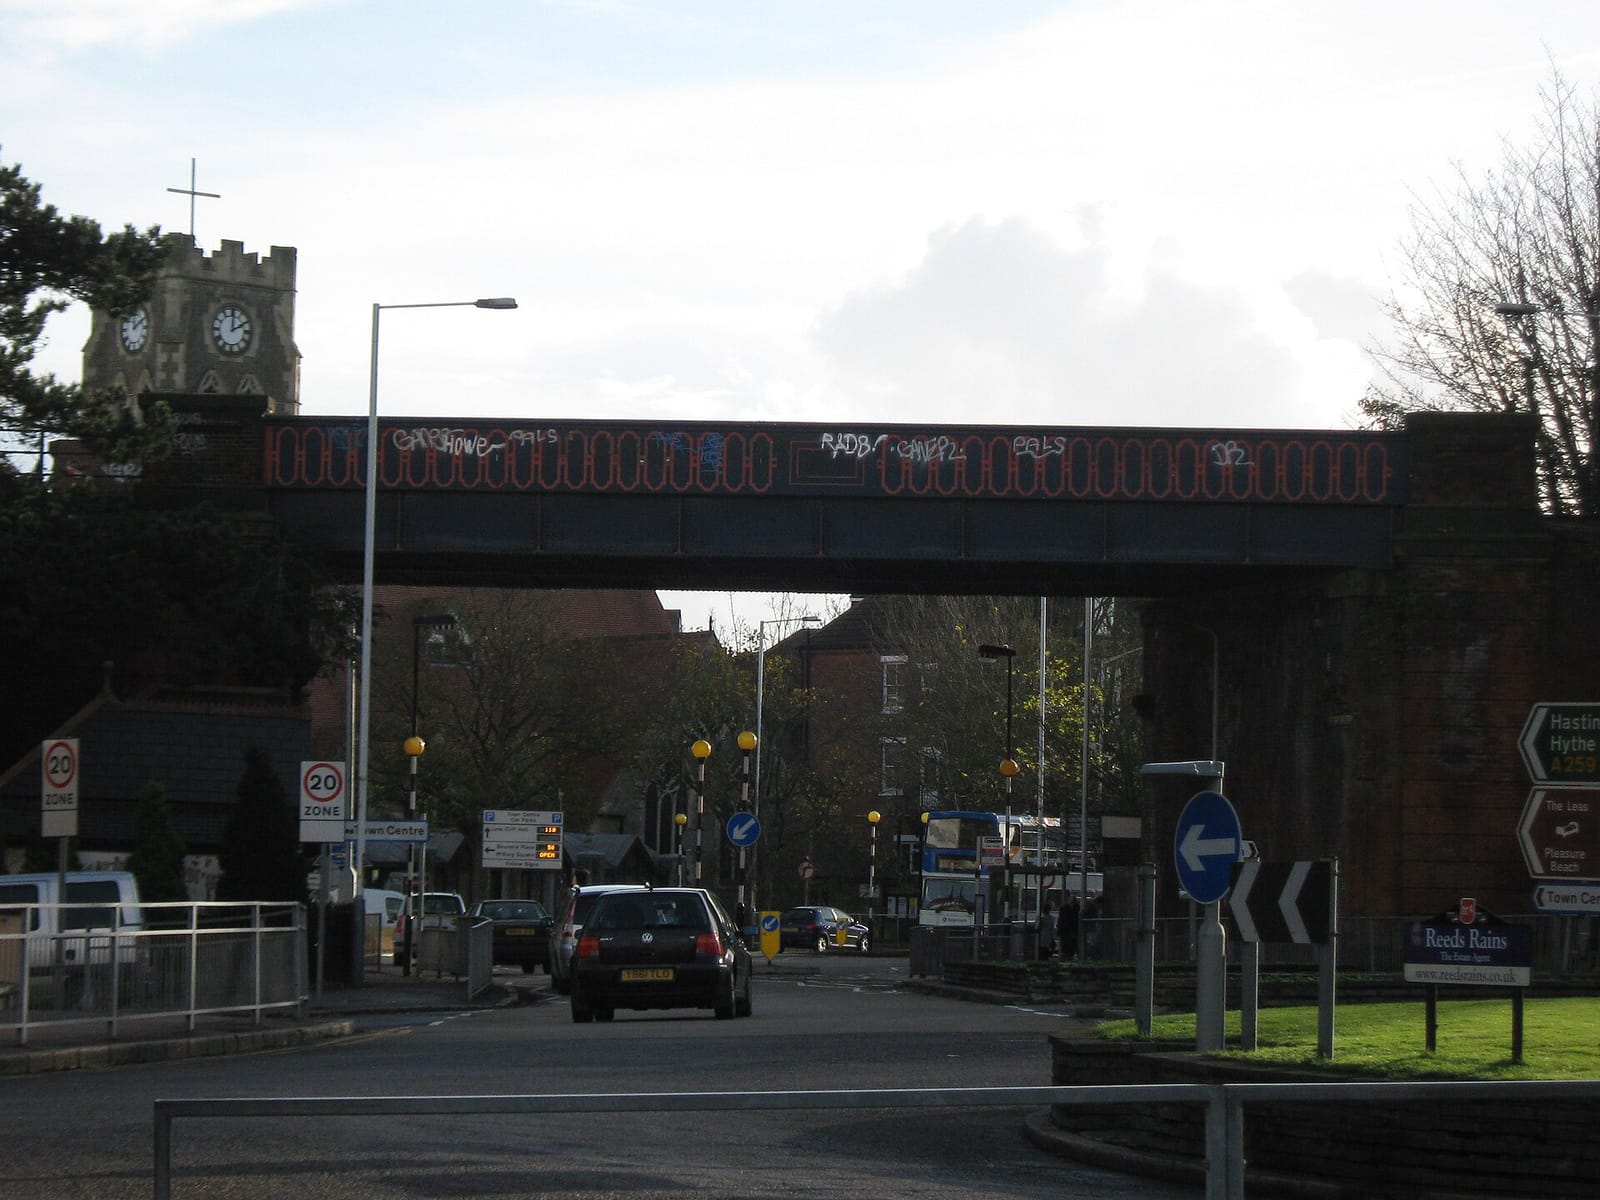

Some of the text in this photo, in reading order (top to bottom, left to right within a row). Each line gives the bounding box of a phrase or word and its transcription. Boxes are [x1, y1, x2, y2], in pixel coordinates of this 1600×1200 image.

[1550, 735, 1596, 755] Hythe
[50, 755, 71, 774] 20
[310, 774, 337, 790] 20
[45, 792, 73, 806] ZONE
[1546, 800, 1589, 812] The Leas
[303, 806, 340, 816] ZONE
[352, 824, 384, 836] Twn
[386, 825, 424, 836] Centre
[1545, 847, 1586, 860] Pleasure
[1550, 861, 1579, 873] Beach
[1547, 890, 1578, 905] Town
[1424, 927, 1508, 950] Reeds Rains
[1415, 966, 1517, 984] www.reedsrains.co.uk
